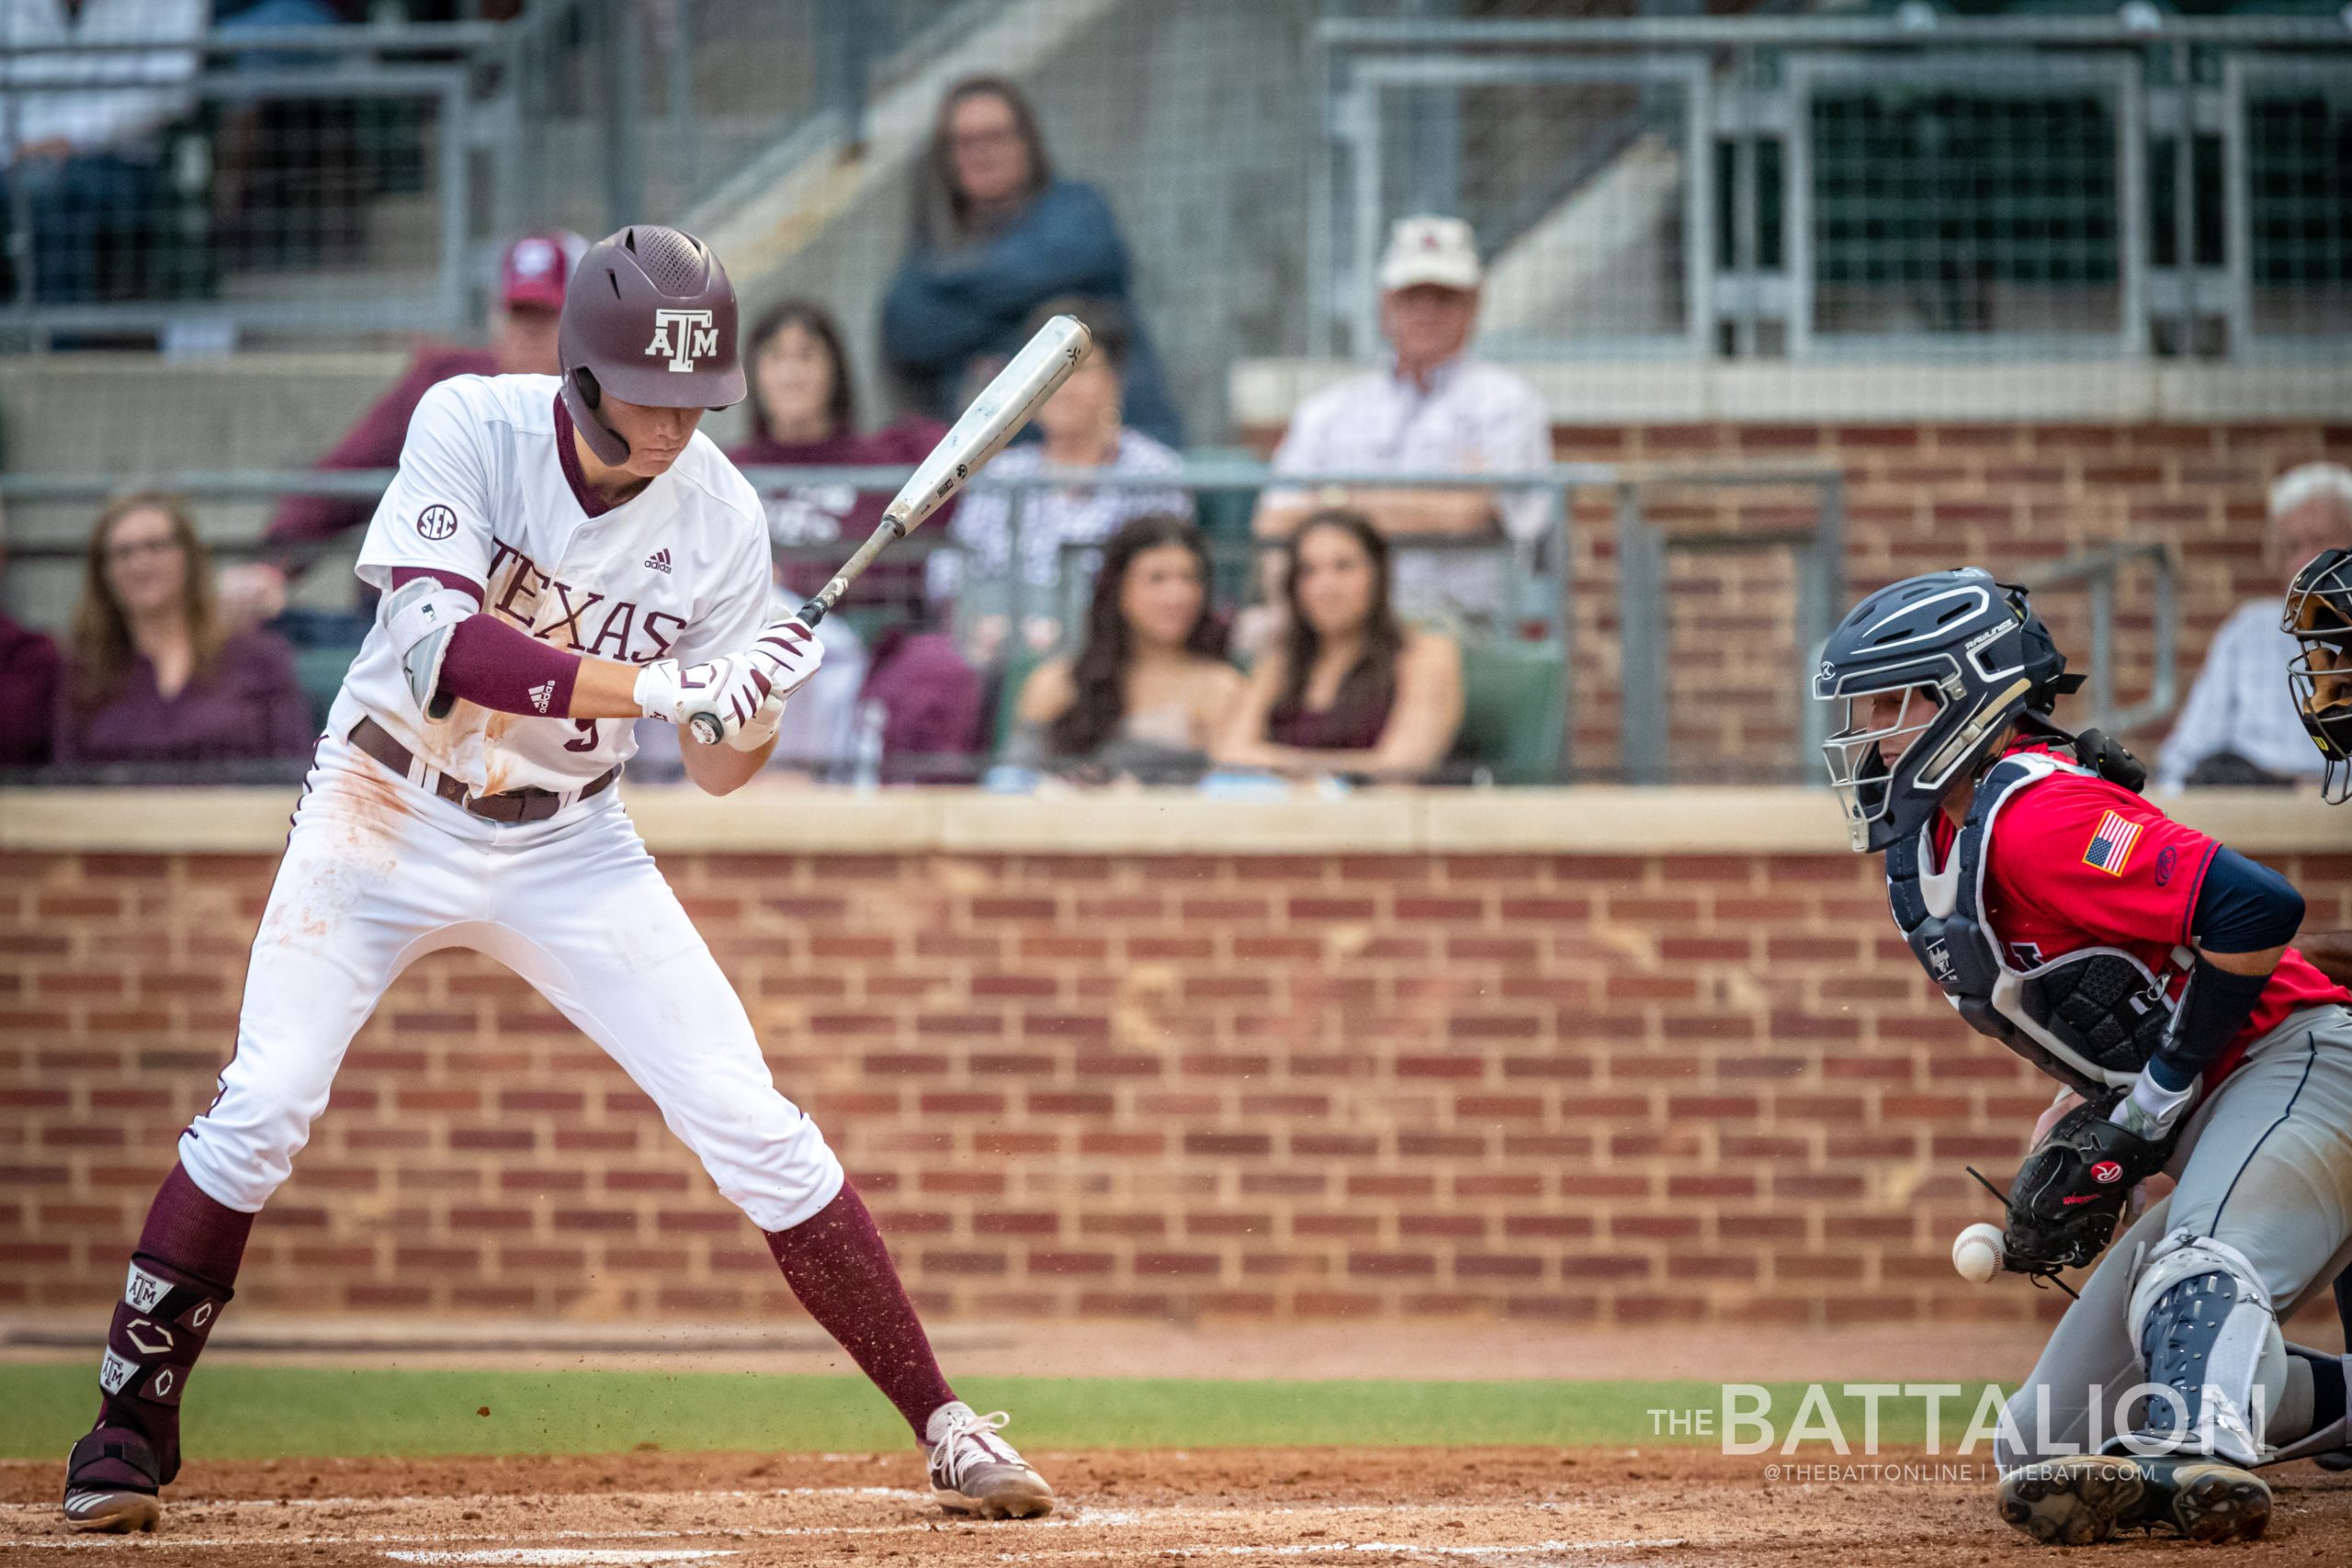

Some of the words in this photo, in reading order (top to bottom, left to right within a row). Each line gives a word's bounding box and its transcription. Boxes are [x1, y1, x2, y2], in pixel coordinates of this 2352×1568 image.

[419, 506, 455, 539] SEC
[644, 559, 672, 575] adidas
[487, 535, 687, 663] TEXAS
[538, 680, 556, 714] adidas
